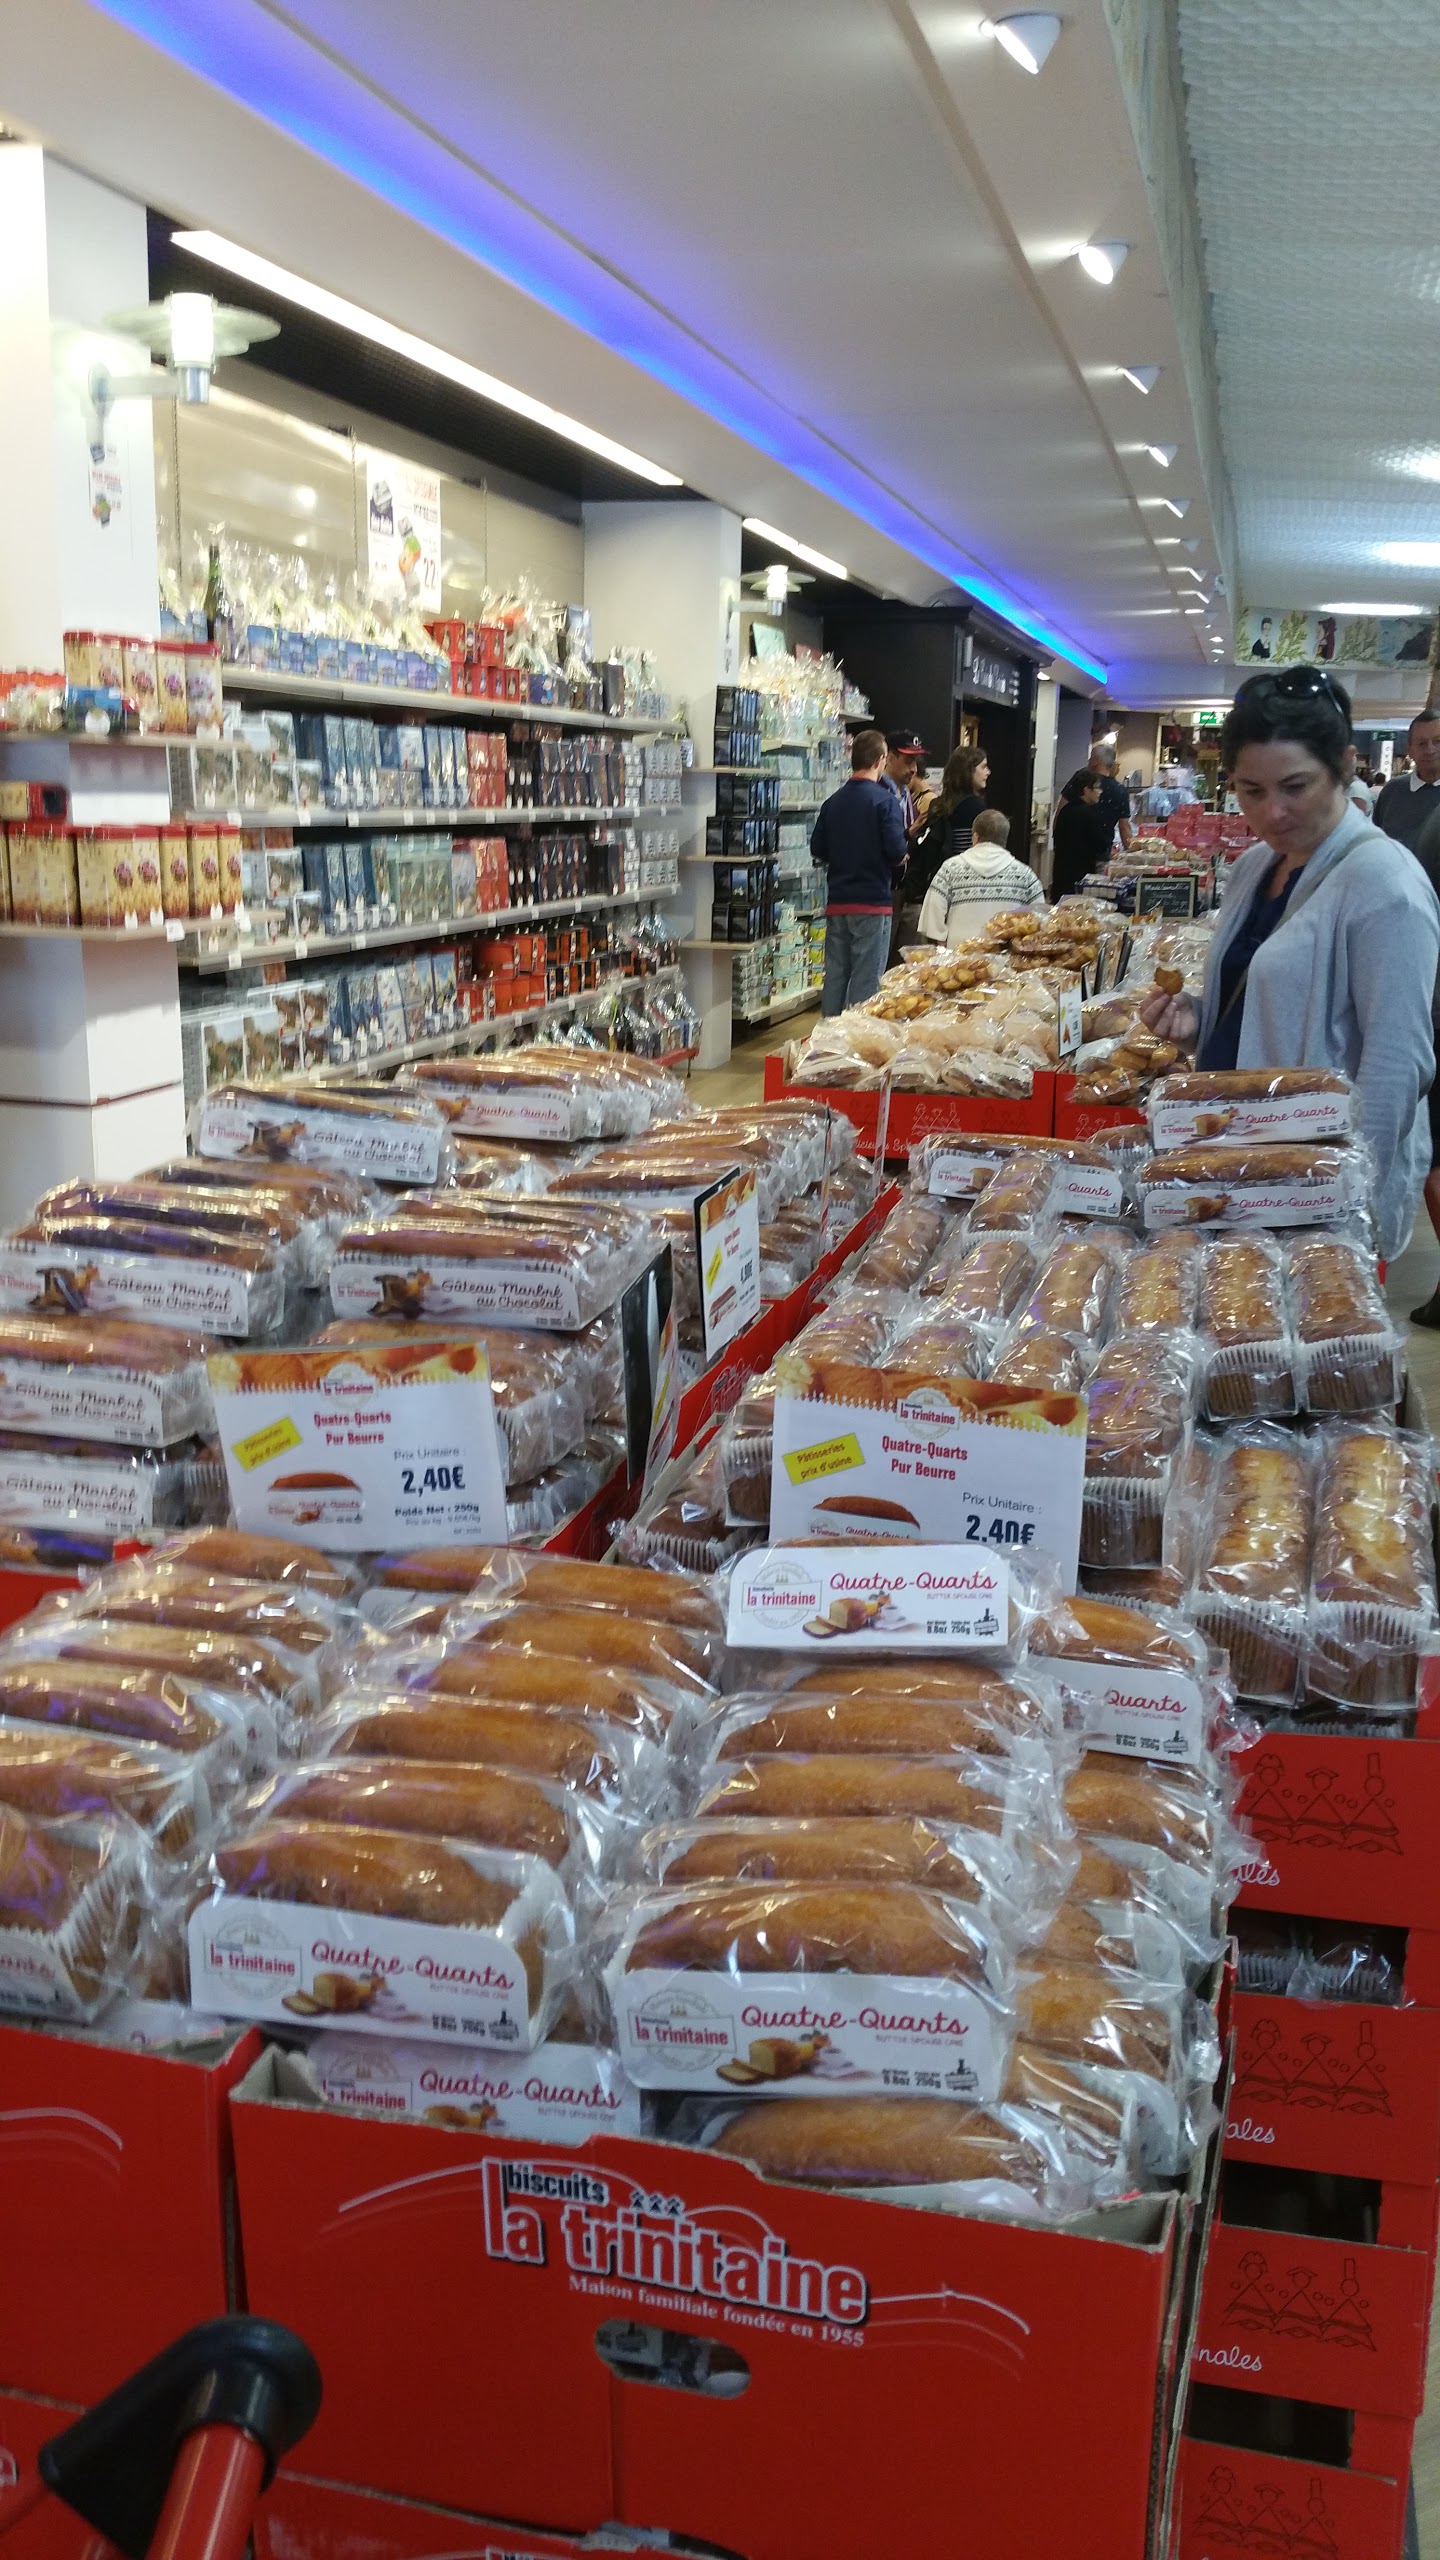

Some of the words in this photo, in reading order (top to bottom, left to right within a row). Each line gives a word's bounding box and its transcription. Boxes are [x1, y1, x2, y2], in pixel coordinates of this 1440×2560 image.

[1245, 1105, 1339, 1124] Quatre-Quarts
[1239, 1197, 1335, 1210] Quatre-Quarts
[441, 1279, 496, 1295] Gâteau
[501, 1282, 563, 1300] Marbré
[476, 1299, 496, 1308] au
[499, 1298, 564, 1312] Chocolat
[313, 1410, 391, 1430] Quatre-Quarts
[900, 1402, 908, 1418] la
[912, 1410, 955, 1425] trinitaine
[326, 1433, 344, 1445] Pur
[347, 1431, 384, 1445] Beurre
[881, 1435, 968, 1461] Quatre-Quarts
[796, 1442, 846, 1465] Pâtisseries
[401, 1464, 466, 1498] 2,40€
[800, 1466, 819, 1479] prix
[890, 1459, 912, 1475] Pur
[914, 1461, 956, 1481] Beurre
[962, 1491, 985, 1506] Prix
[988, 1495, 1034, 1514] Unitaire
[829, 1571, 998, 1591] Quatre-Quarts
[747, 1587, 757, 1606] la
[762, 1592, 816, 1606] trinitaine
[210, 1943, 223, 1967] la
[228, 1953, 296, 1976] trinitaine
[311, 1938, 514, 1991] Quatre-Quarts
[635, 2016, 650, 2040] la
[655, 2025, 729, 2046] trinitaine
[741, 2005, 969, 2035] Quatre-Quarts
[340, 2088, 406, 2110] trinitaine
[419, 2068, 622, 2110] Quatre-Quarts
[506, 2164, 608, 2206] biscuits
[482, 2157, 546, 2266] la
[560, 2204, 870, 2325] trinitaine
[638, 2288, 718, 2320] familiale
[723, 2303, 785, 2333] fondée
[790, 2323, 814, 2338] en
[821, 2323, 865, 2348] 1955
